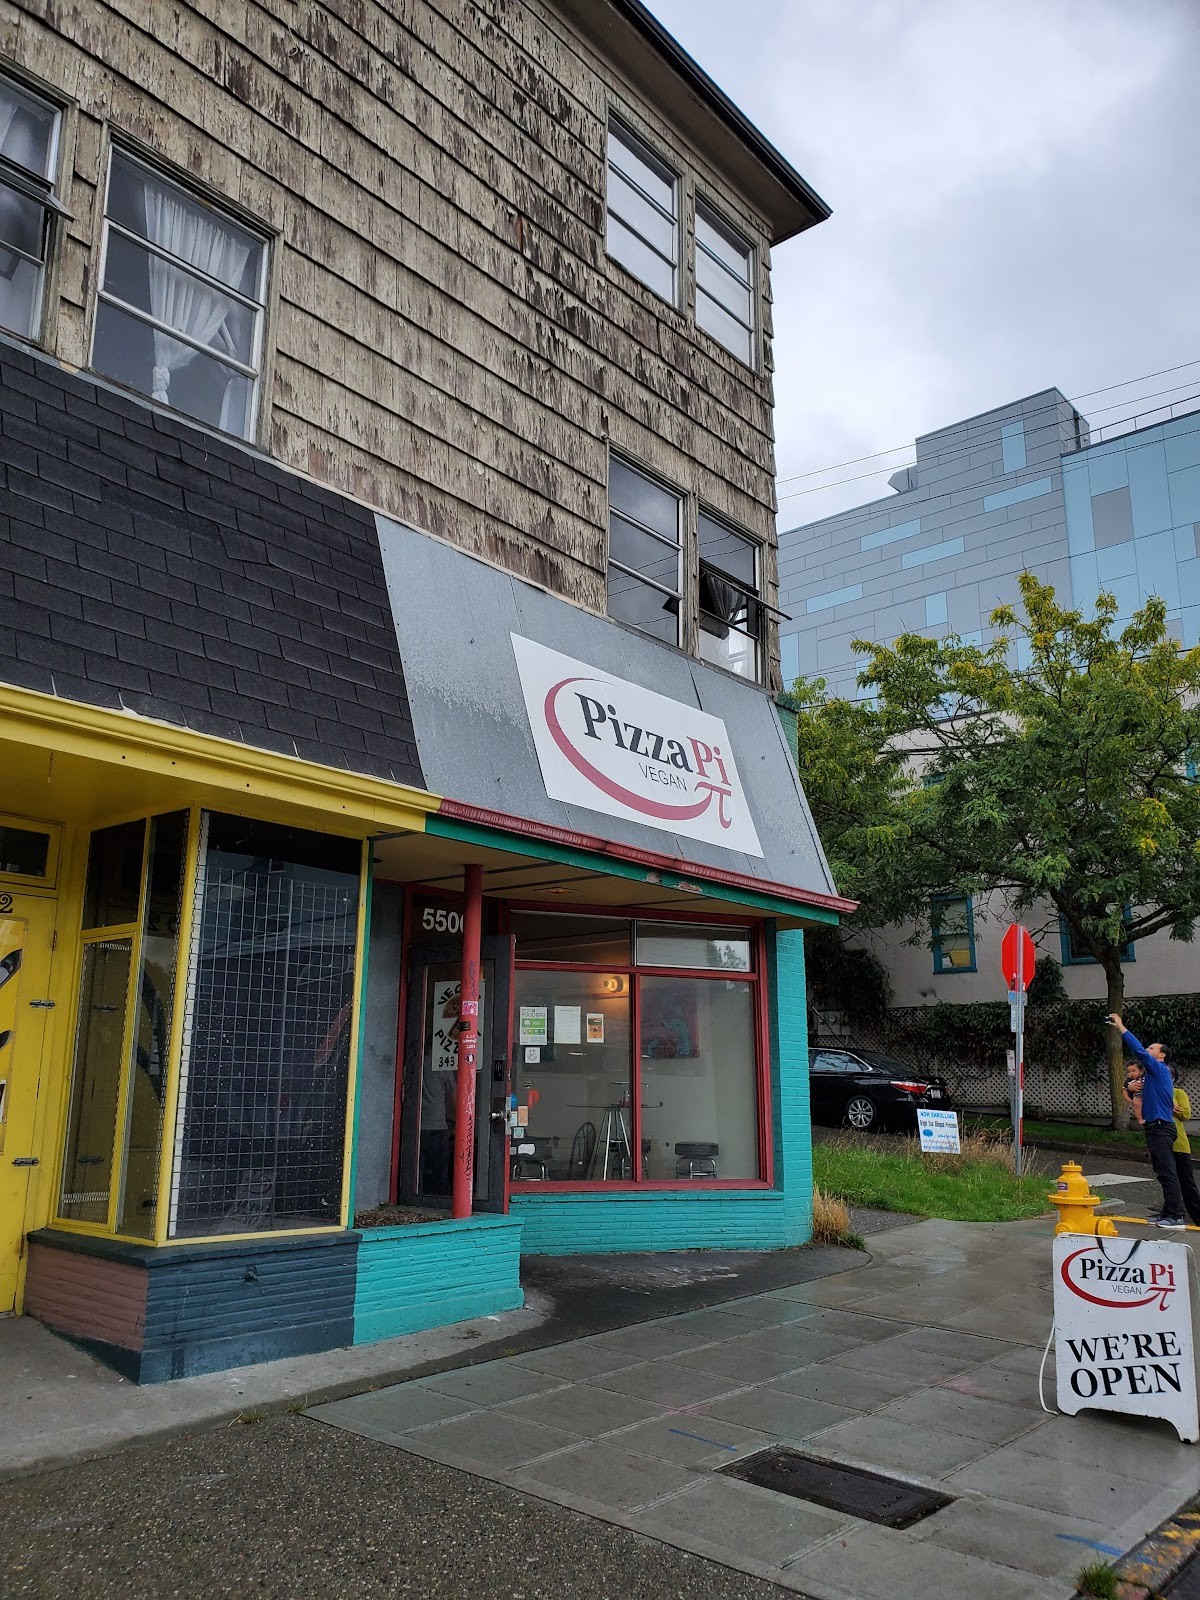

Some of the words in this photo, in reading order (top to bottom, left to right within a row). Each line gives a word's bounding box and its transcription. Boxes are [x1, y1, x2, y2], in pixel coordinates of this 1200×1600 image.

[574, 692, 693, 773] Pizza
[686, 736, 731, 786] Pi
[638, 762, 688, 792] VEGAN
[1079, 1258, 1147, 1284] Pizza
[1148, 1263, 1176, 1287] Pi
[1111, 1284, 1142, 1295] VEGAN
[1065, 1331, 1182, 1363] WE'RE
[1070, 1363, 1182, 1398] OPEN
